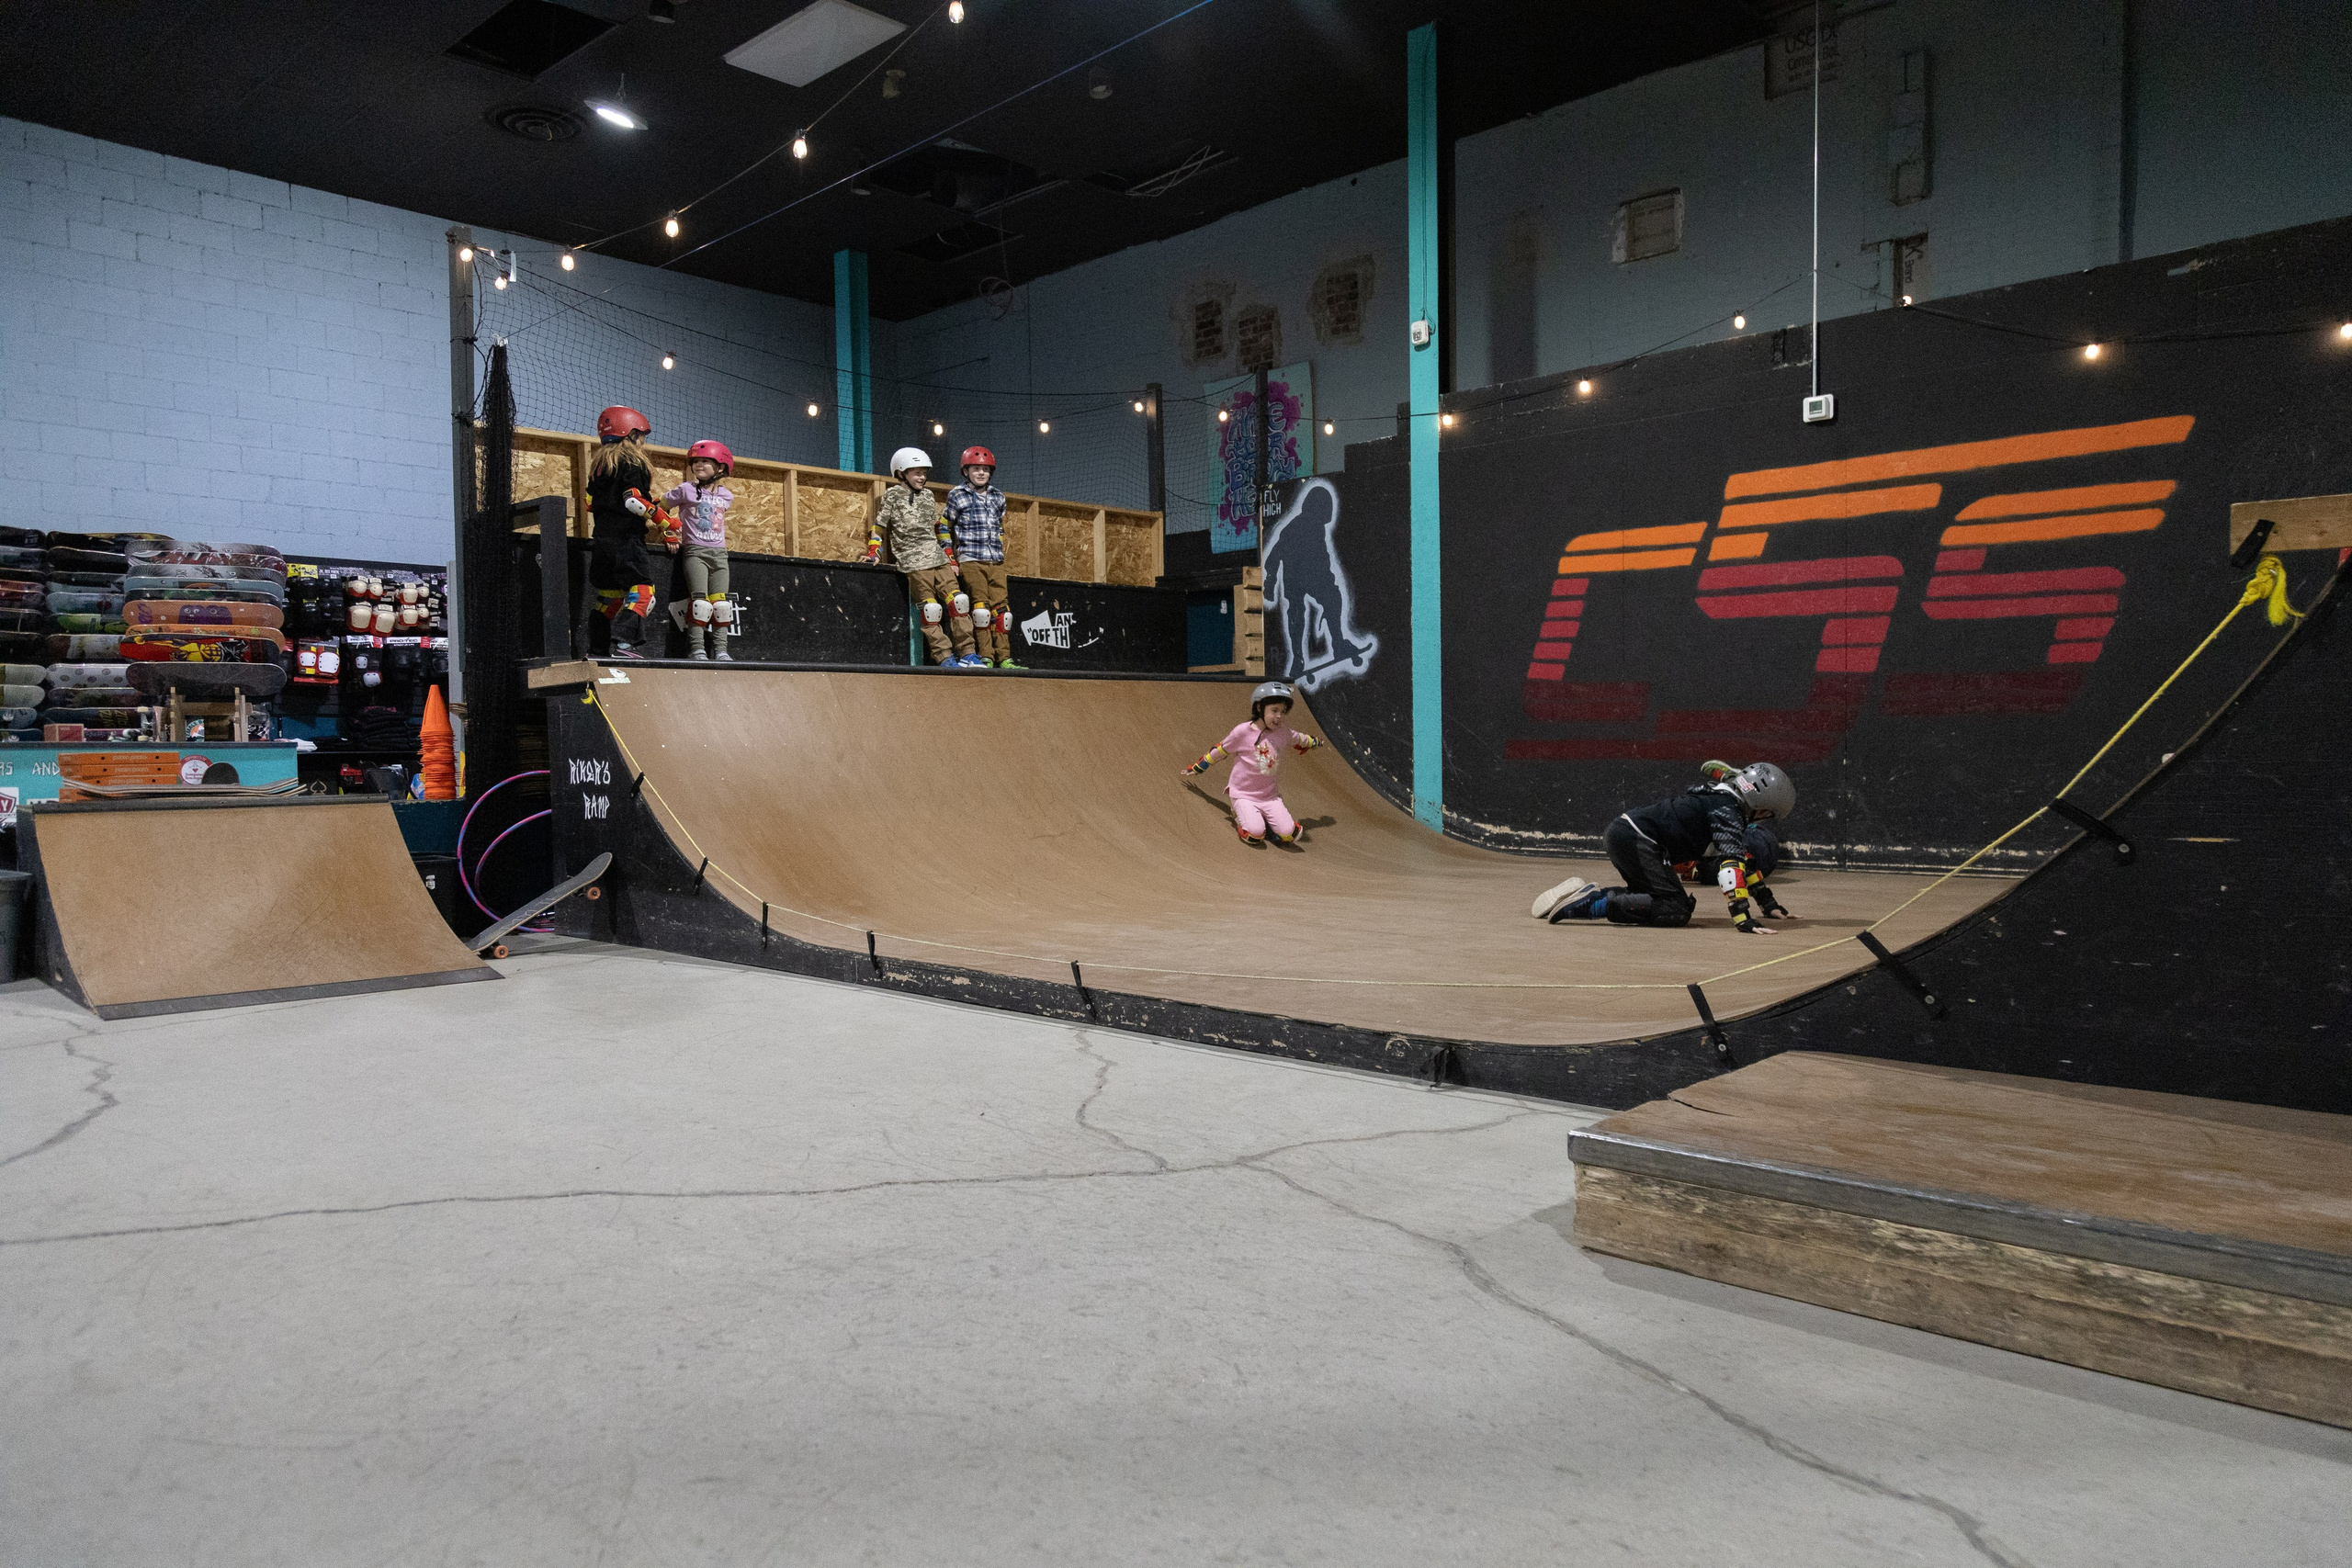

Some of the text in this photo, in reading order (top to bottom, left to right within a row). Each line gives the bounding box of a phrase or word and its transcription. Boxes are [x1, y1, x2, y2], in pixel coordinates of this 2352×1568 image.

[1227, 400, 1286, 443] HAE
[1225, 430, 1289, 461] YOR
[1264, 489, 1280, 502] FLY
[1263, 502, 1282, 516] HIGH
[31, 761, 60, 775] AND
[582, 792, 610, 819] RAMP
